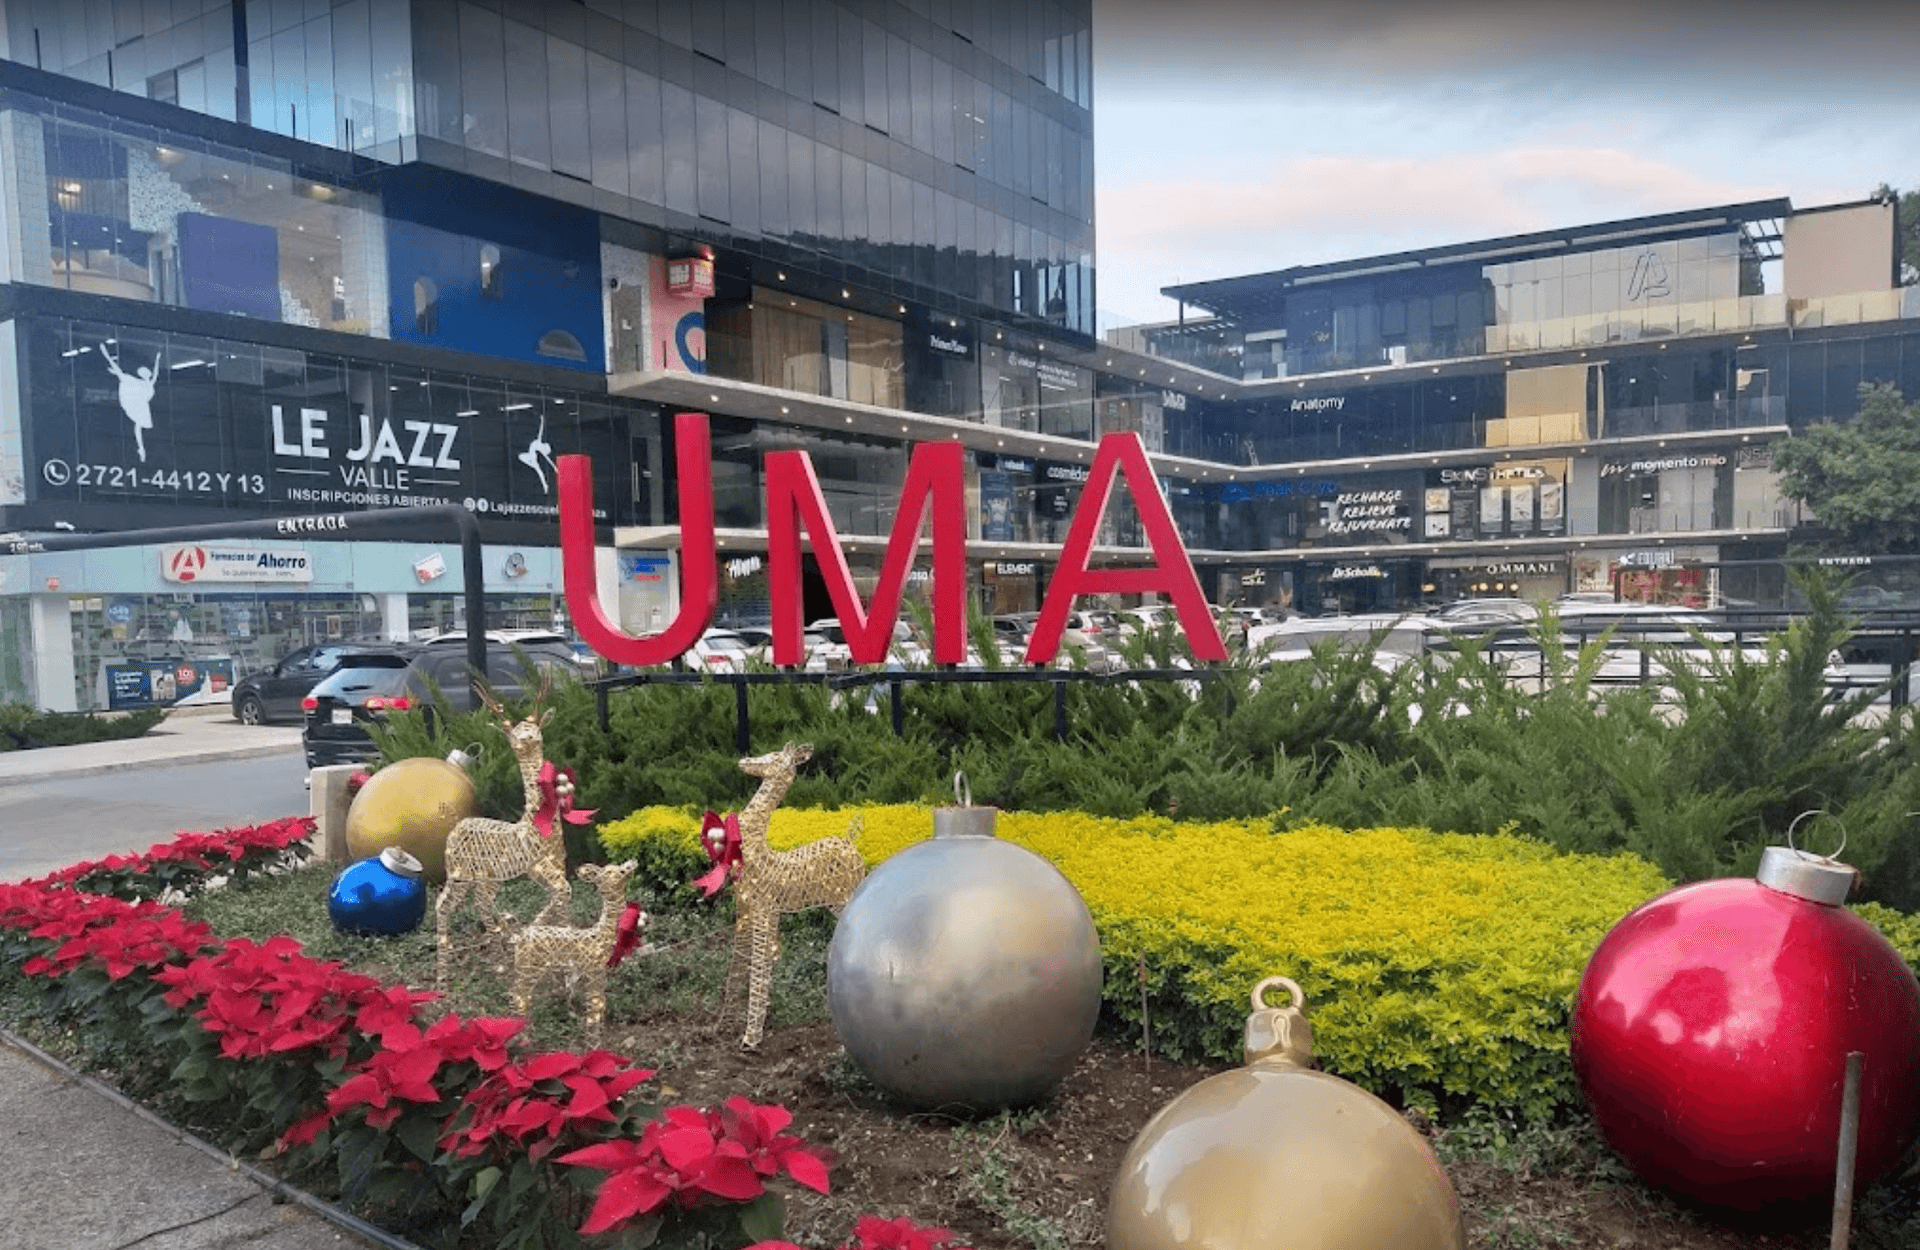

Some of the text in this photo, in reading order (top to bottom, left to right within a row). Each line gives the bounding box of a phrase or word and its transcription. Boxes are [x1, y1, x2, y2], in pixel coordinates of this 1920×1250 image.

[1290, 396, 1345, 412] Anatomy
[271, 404, 461, 470] LE JAZZ
[1631, 457, 1698, 471] momento
[75, 463, 265, 495] 2721-4412 Y 13
[339, 465, 410, 491] VALLE
[287, 488, 390, 506] INSCRIPCIONES
[1336, 490, 1402, 505] RECHARGE
[1342, 505, 1397, 518] RELIEVE
[277, 516, 349, 534] ENTRADA
[1328, 517, 1412, 534] REJUVENATE
[556, 413, 1228, 665] UMA
[257, 553, 307, 569] Ahorro
[1487, 563, 1556, 575] OMMANI
[1819, 557, 1872, 566] ENTRADA
